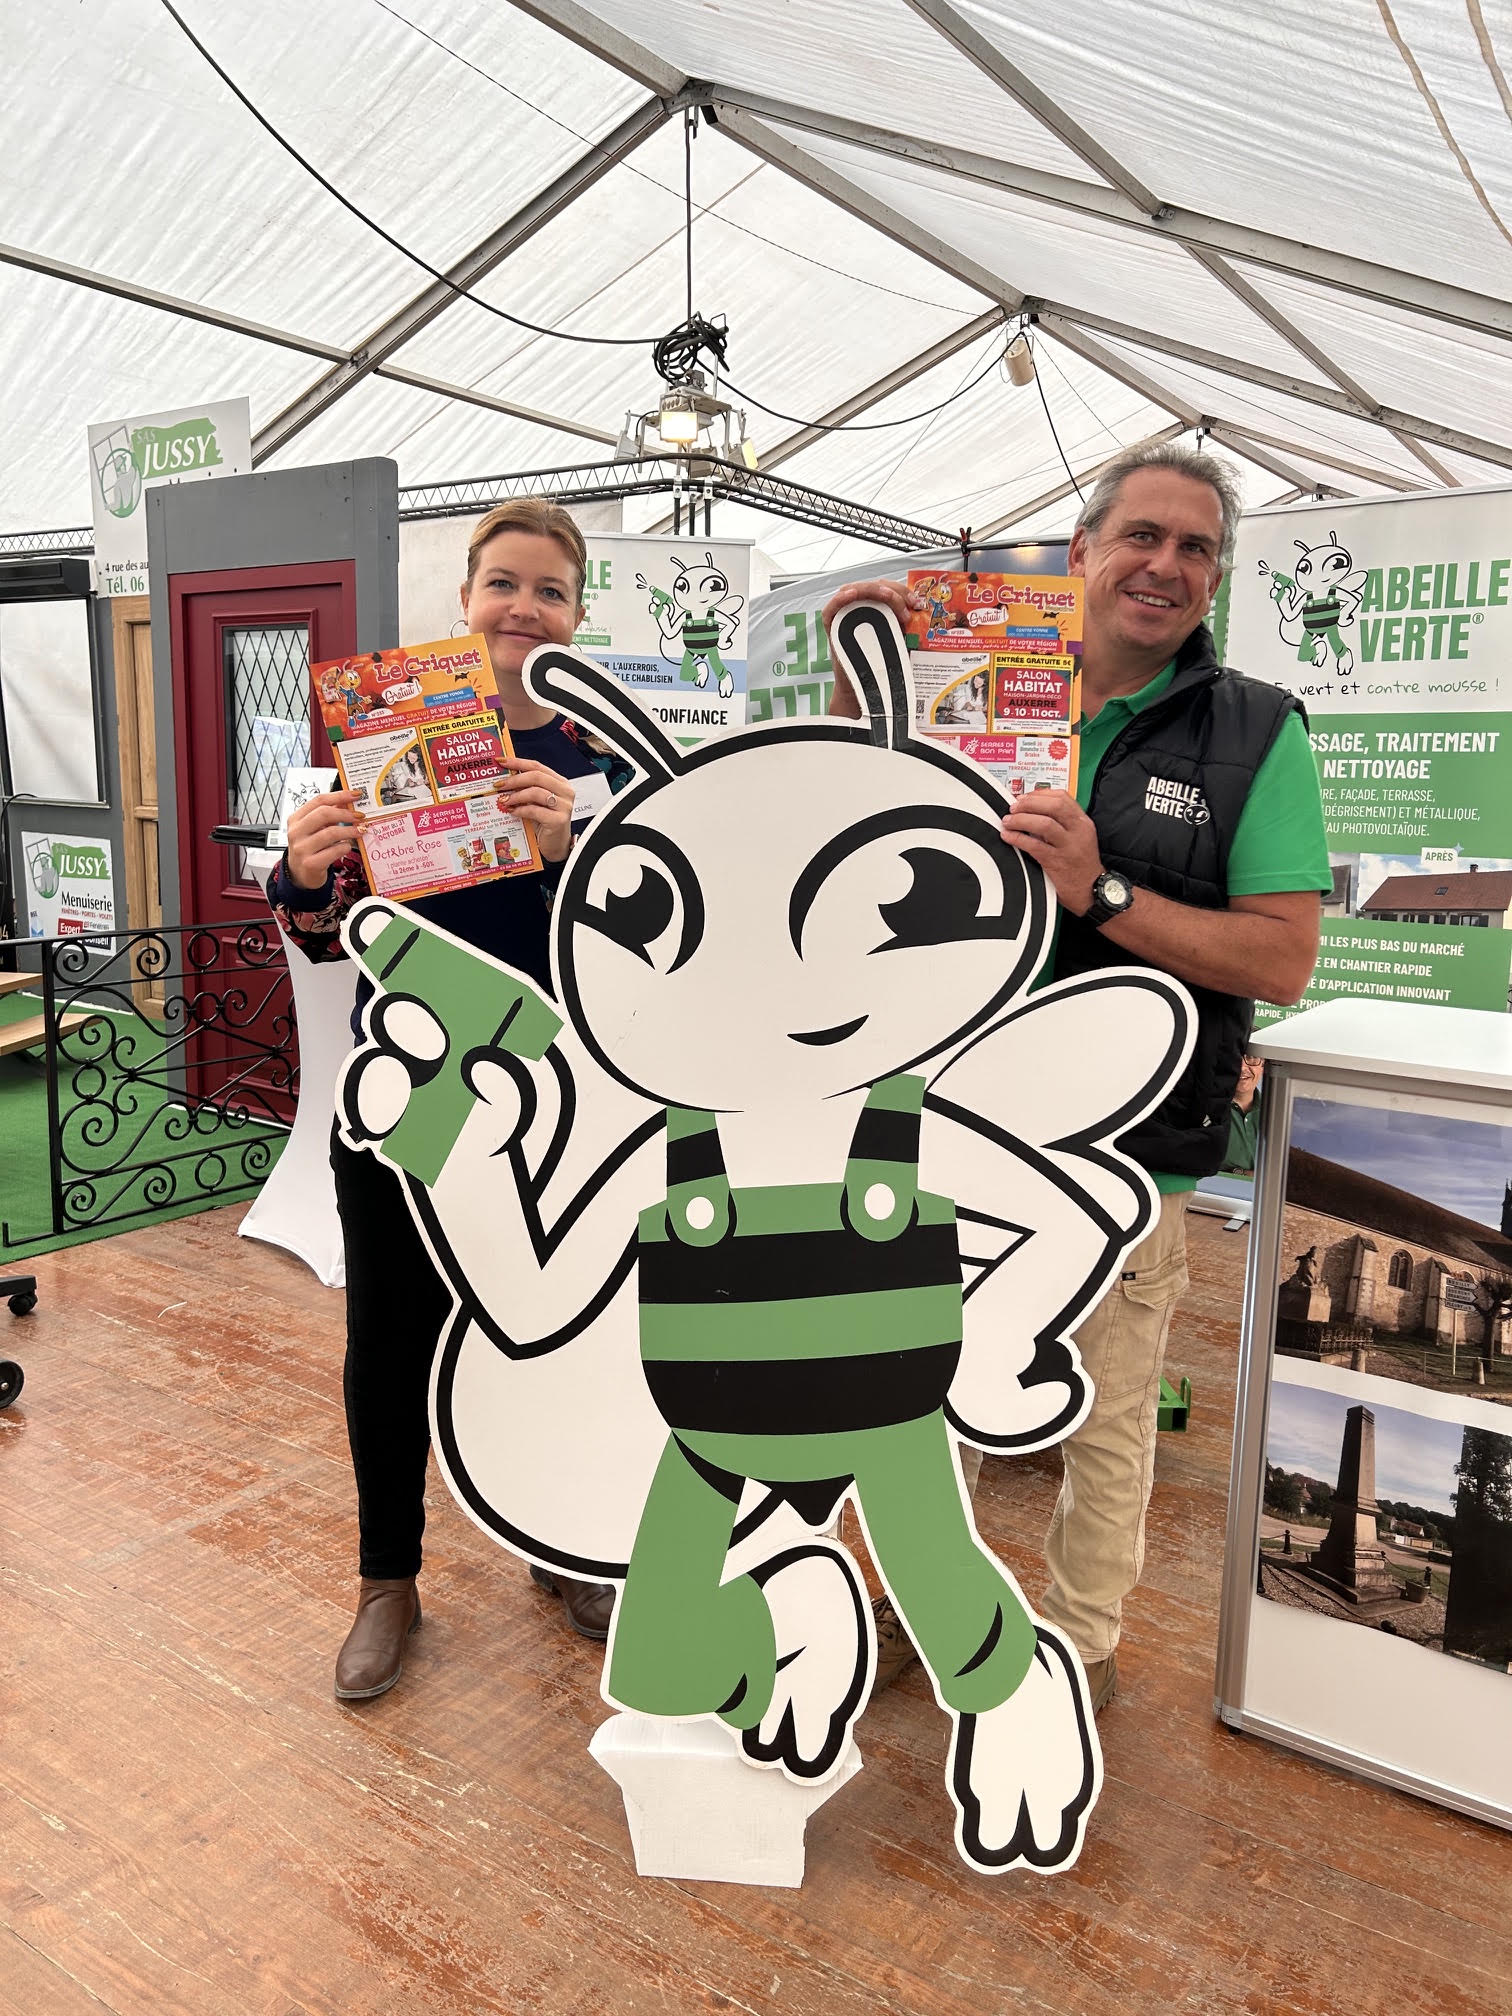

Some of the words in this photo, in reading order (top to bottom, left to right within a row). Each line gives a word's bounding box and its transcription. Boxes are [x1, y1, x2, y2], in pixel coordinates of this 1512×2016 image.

[137, 430, 156, 443] SAS
[143, 434, 212, 477] JUSSY
[105, 563, 109, 572] 4
[126, 560, 137, 571] des
[106, 576, 127, 594] Tél.
[130, 576, 144, 592] 06
[1360, 560, 1511, 613] ABEILLE
[967, 585, 994, 603] Le
[997, 586, 1075, 610] Criquet
[970, 610, 1002, 625] Gratuit
[373, 662, 400, 683] Le
[404, 649, 482, 674] Criquet
[613, 662, 659, 672] L'AUXERROIS,
[632, 674, 672, 683] CHABLISIEN
[1017, 671, 1051, 680] SALON
[1004, 681, 1063, 693] HABITAT
[1300, 681, 1334, 696] vert
[1342, 681, 1360, 695] et
[1368, 680, 1420, 694] contre
[1429, 680, 1488, 693] mousse
[385, 687, 415, 704] Gratuit
[1009, 699, 1057, 708] AUXERRE
[352, 721, 379, 730] MAGAZINE
[380, 715, 405, 726] MENSUEL
[407, 710, 429, 720] GRATUIT
[439, 705, 456, 713] VOTRE
[456, 701, 477, 709] RÉGION
[1015, 708, 1026, 716] 10
[1041, 710, 1061, 718] OCT.
[423, 724, 450, 734] ENTRÉE
[451, 717, 485, 729] GRATUITE
[446, 732, 480, 745] SALON
[1310, 732, 1369, 754] SSAGE,
[1376, 732, 1499, 753] TRAITEMENT
[437, 739, 493, 760] HABITAT
[447, 758, 493, 773] AUXERRE
[1323, 759, 1432, 779] NETTOYAGE
[455, 773, 466, 781] 10
[480, 766, 500, 776] OCT.
[1146, 776, 1200, 804] ABEILLE
[1340, 789, 1379, 803] FAÇADE,
[1382, 790, 1436, 803] TERRASSE,
[1145, 792, 1186, 819] VERTE
[1399, 806, 1410, 819] ET
[1414, 804, 1481, 821] MÉTALLIQUE,
[451, 813, 466, 821] PAIN
[378, 827, 406, 841] OCTOBRE
[1343, 822, 1430, 837] PHOTOVOLTAÏQUE.
[416, 840, 441, 853] Rose
[1425, 851, 1453, 862] APRÈS
[59, 855, 104, 877] JUSSY
[62, 891, 112, 912] Menuiserie
[99, 912, 113, 920] VOLETS
[60, 922, 81, 935] Expert
[1330, 936, 1349, 948] LES
[1351, 937, 1378, 950] PLUS
[1380, 938, 1401, 952] BAS
[1403, 940, 1417, 953] DU
[1420, 941, 1464, 956] MARCHÉ
[1324, 958, 1338, 970] EN
[1340, 958, 1392, 974] CHANTIER
[1394, 962, 1432, 977] RAPIDE
[1319, 978, 1394, 997] D'APPLICATION
[1396, 984, 1451, 1001] INNOVANT
[1255, 1008, 1284, 1019] RAPIDE,
